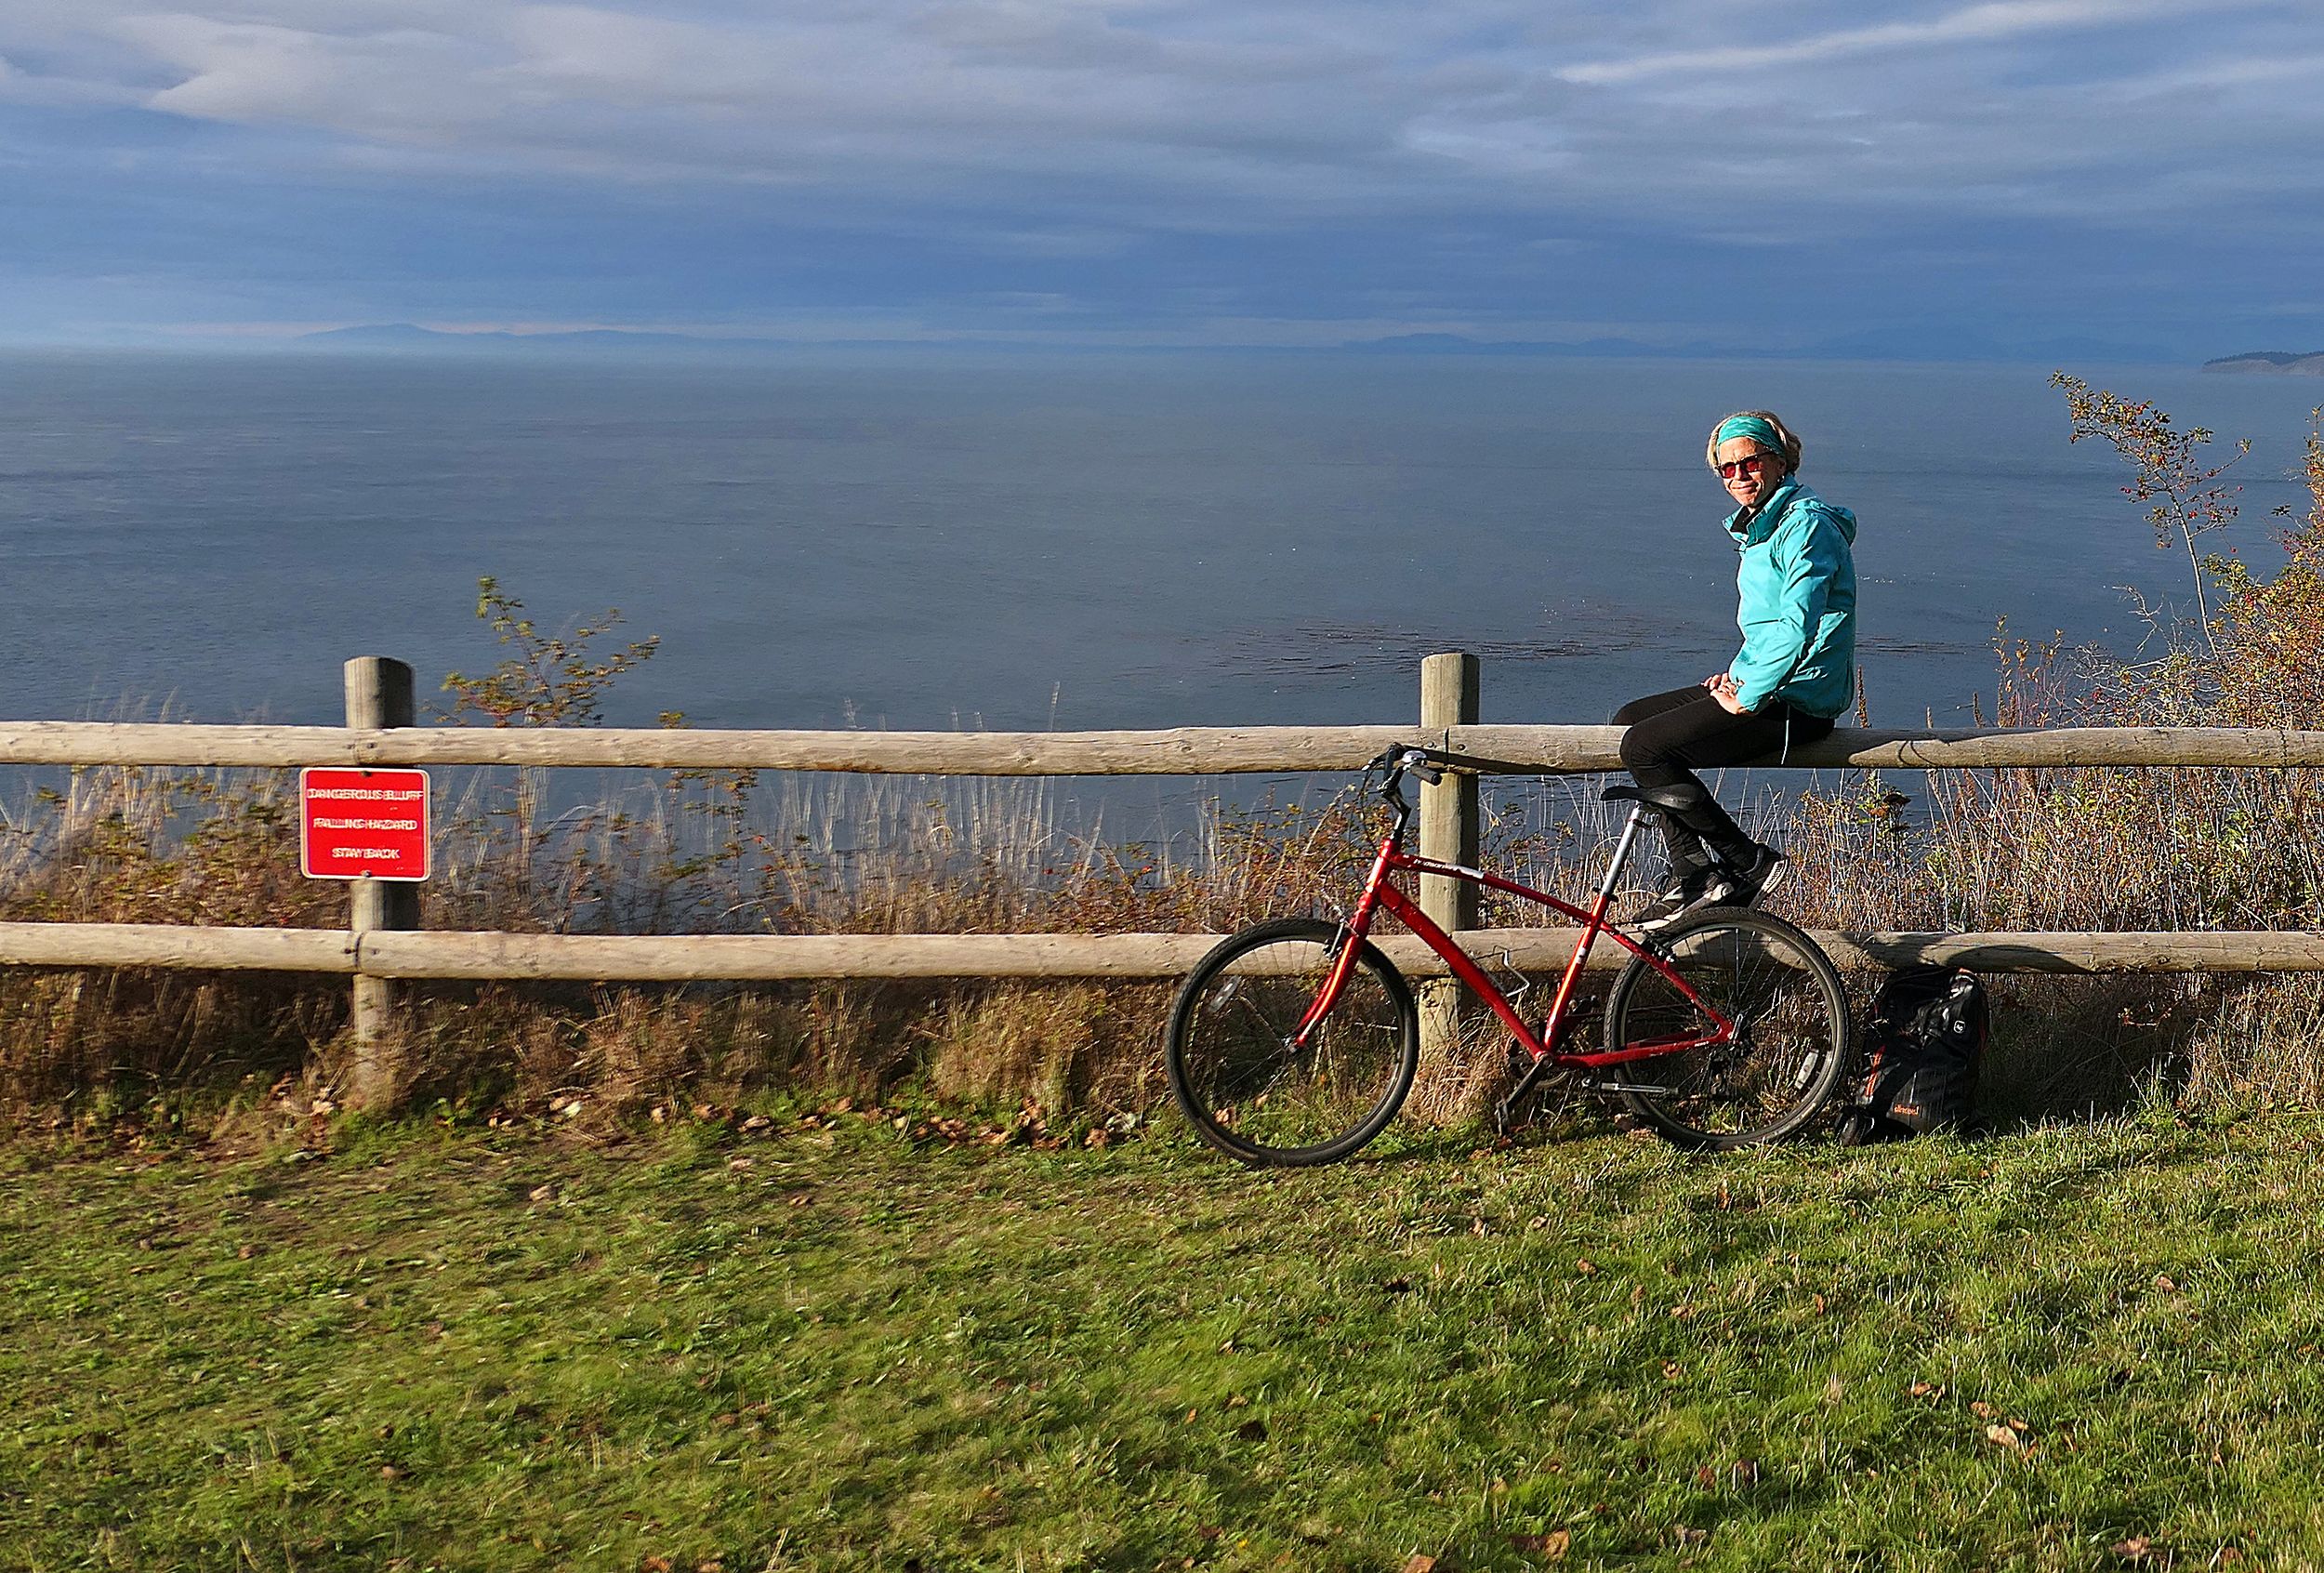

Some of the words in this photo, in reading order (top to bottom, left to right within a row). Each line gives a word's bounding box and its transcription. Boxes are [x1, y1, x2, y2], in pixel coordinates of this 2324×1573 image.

[307, 788, 383, 800] DANGEROUS
[383, 790, 423, 800] BLUFF
[313, 817, 365, 829] FALLING
[365, 819, 417, 830] HAZARD
[332, 847, 363, 858] STAY
[363, 848, 401, 859] BACK
